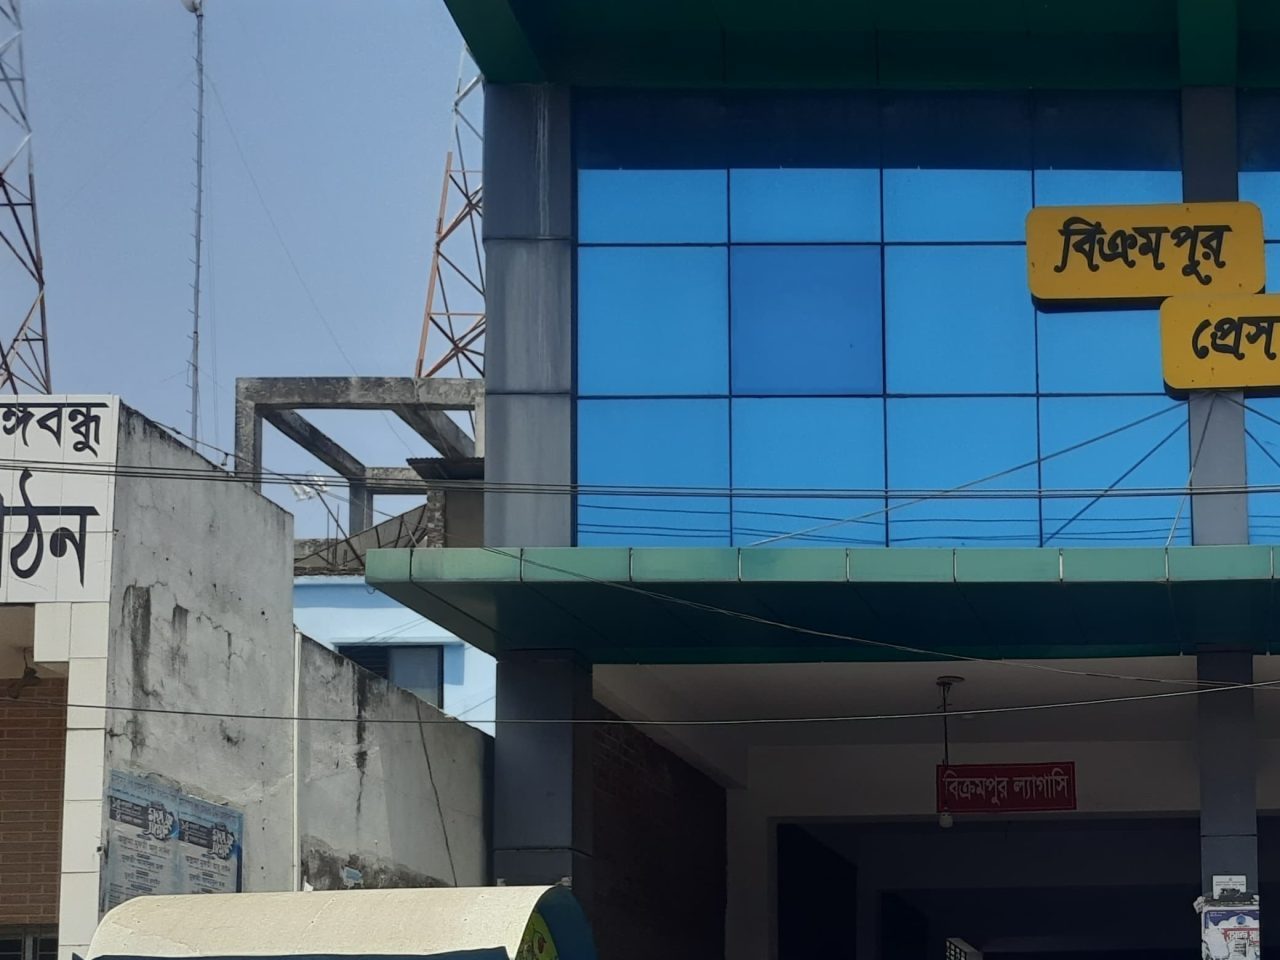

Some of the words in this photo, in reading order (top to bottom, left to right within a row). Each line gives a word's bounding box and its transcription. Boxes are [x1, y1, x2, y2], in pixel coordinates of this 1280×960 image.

[1054, 217, 1232, 285] বিক্রমপুর
[0, 402, 109, 458] ঙ্গবন্ধু
[0, 467, 100, 588] ঠন
[943, 770, 1009, 806] বিক্রমপুর
